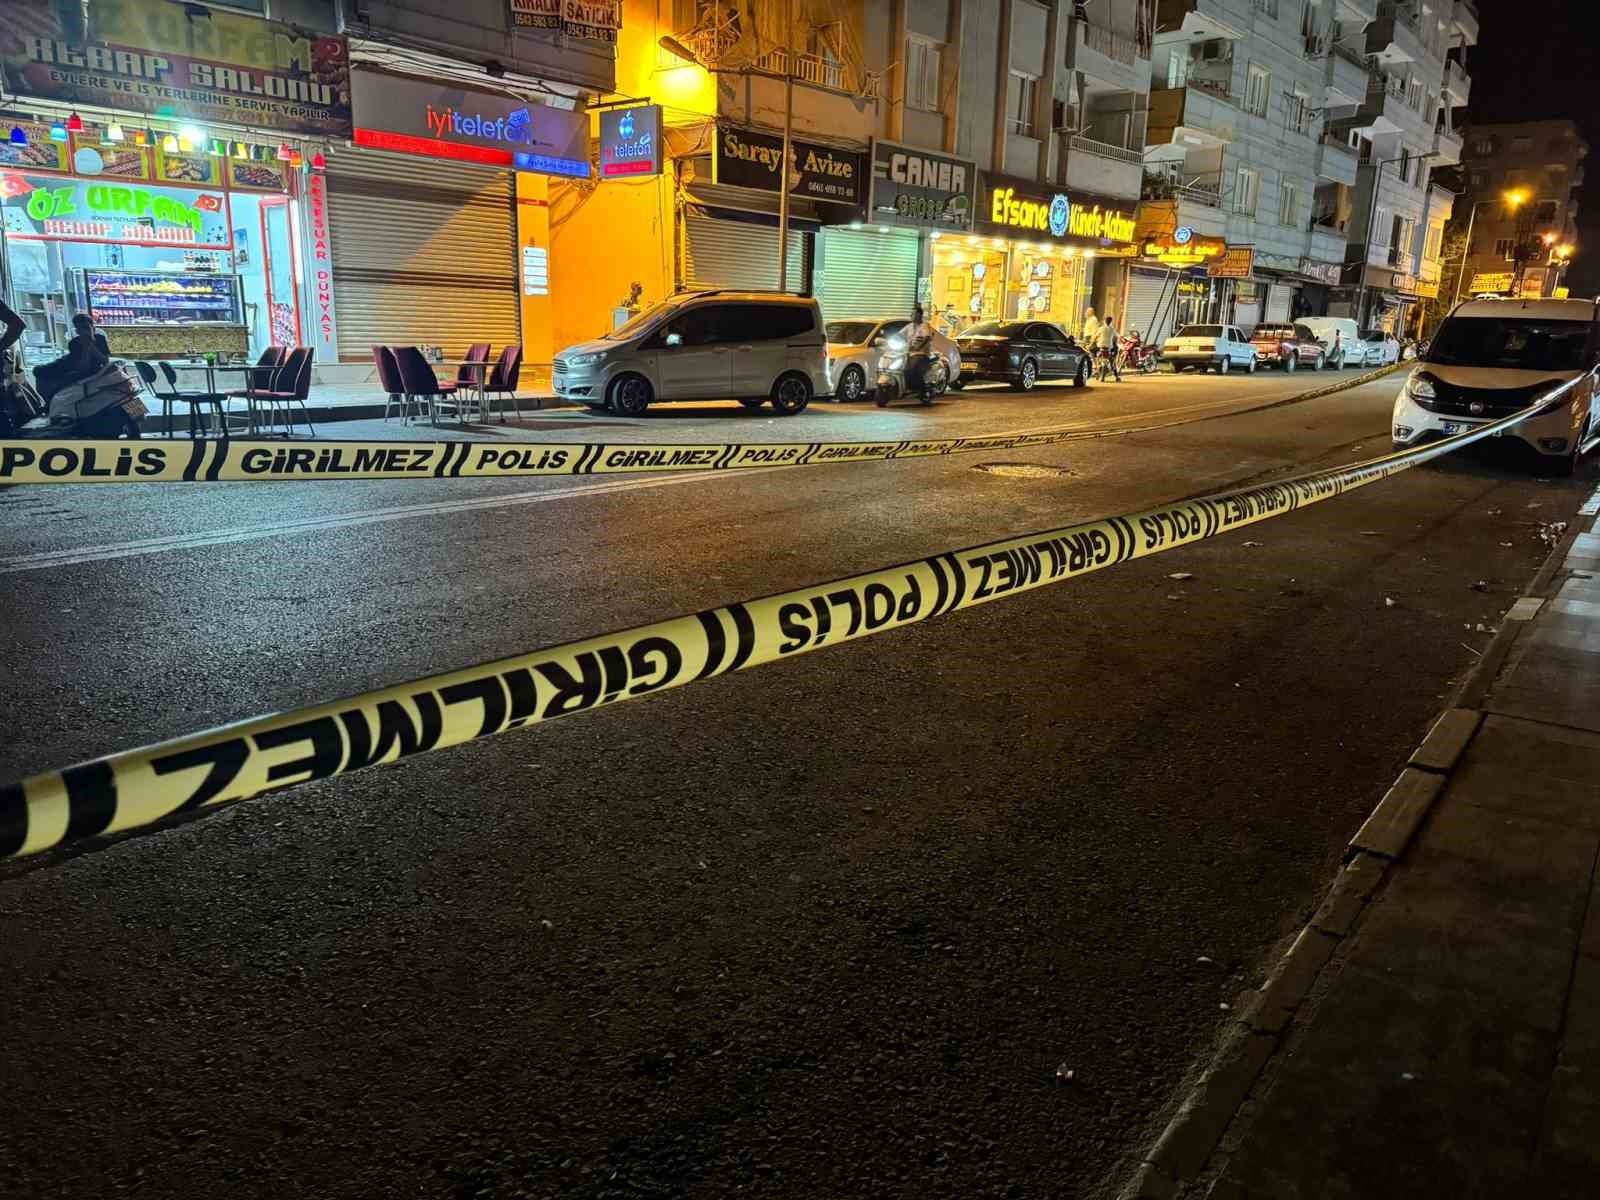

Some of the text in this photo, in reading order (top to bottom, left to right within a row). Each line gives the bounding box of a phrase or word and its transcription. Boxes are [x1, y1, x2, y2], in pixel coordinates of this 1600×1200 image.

[51, 70, 109, 89] EVLERE
[112, 78, 132, 93] VE
[189, 62, 331, 105] SALONU
[723, 133, 853, 178] Saray Avize
[891, 153, 966, 193] CANER
[86, 185, 202, 233] URFAM
[992, 188, 1049, 231] Efsane
